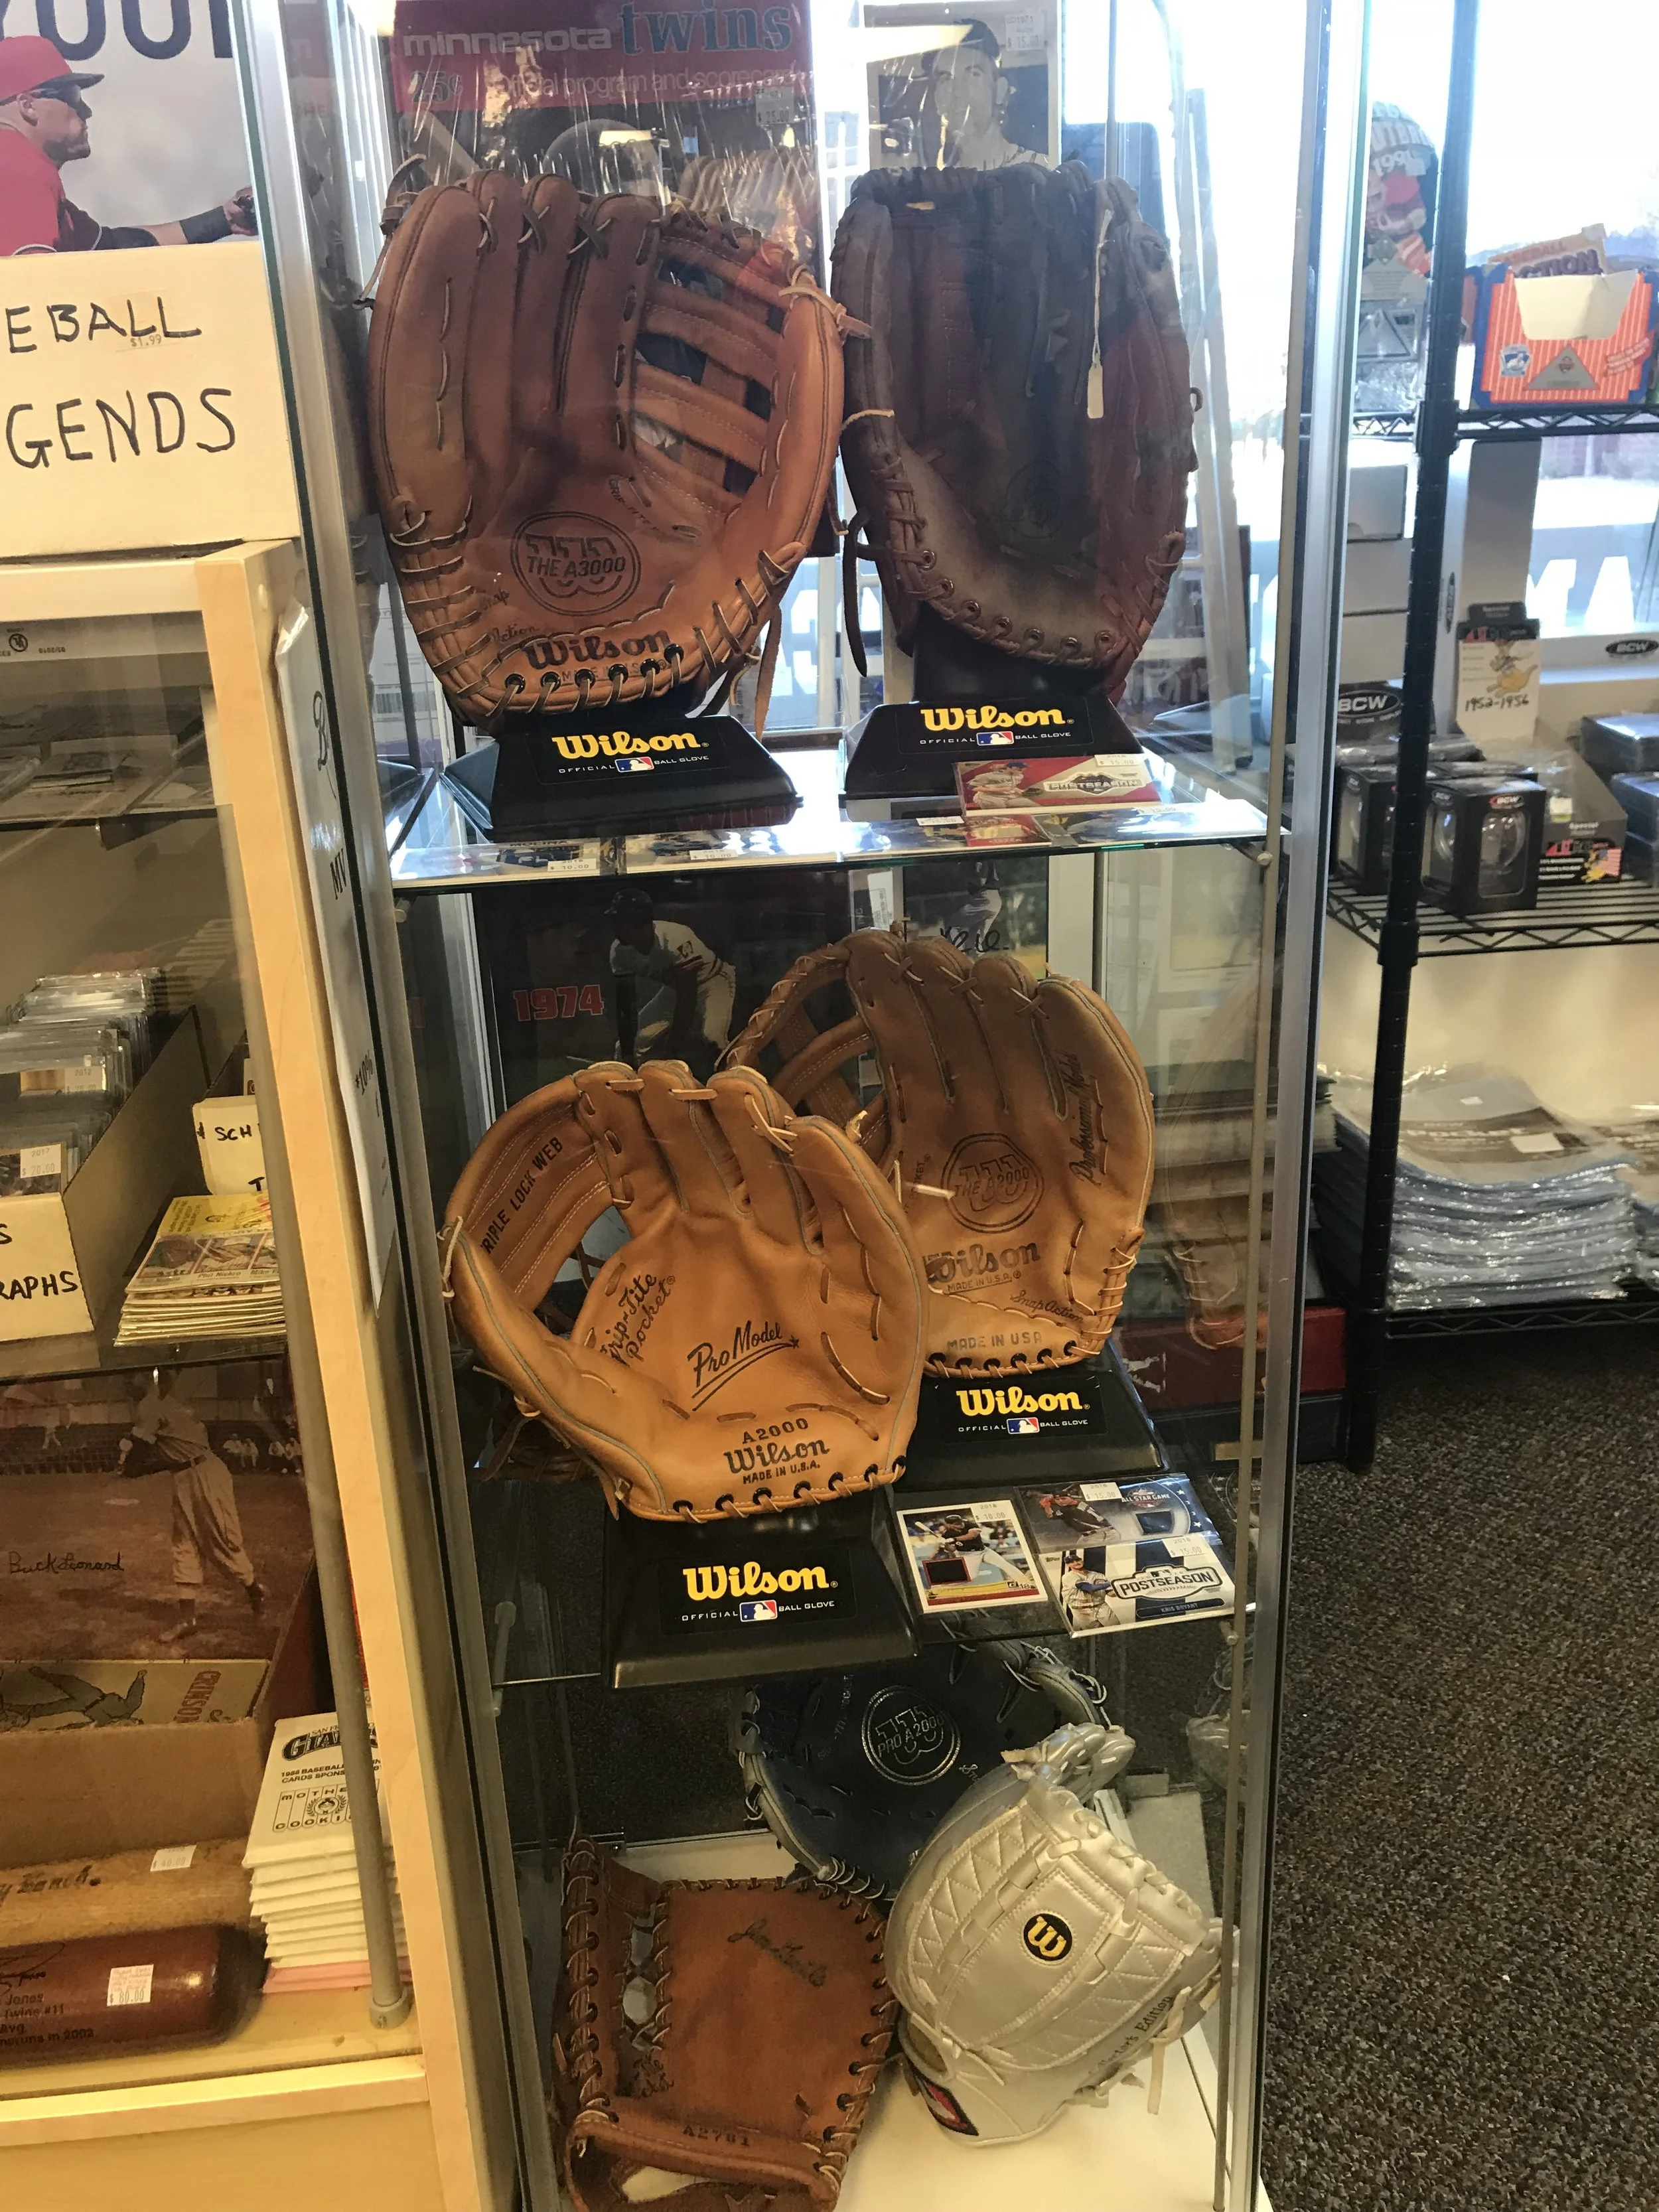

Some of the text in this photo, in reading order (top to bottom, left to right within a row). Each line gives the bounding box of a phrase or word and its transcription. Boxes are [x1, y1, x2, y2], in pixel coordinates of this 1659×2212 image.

[403, 0, 792, 56] minnesota twins
[6, 297, 202, 353] EBALL
[130, 334, 161, 347] $1.99
[6, 388, 235, 469] GENDS
[527, 556, 626, 577] THE A3000
[522, 630, 671, 670] Wilson
[1338, 695, 1388, 712] BCW
[559, 765, 615, 773] OFFICIAL
[512, 984, 605, 1022] 1974
[31, 1147, 50, 1158] 2017
[31, 1163, 56, 1176] 20.00
[511, 1173, 536, 1212] LOCK
[532, 1136, 564, 1173] WEB
[948, 1281, 973, 1291] MADE
[1009, 1290, 1045, 1313] Snap
[947, 1331, 1044, 1350] MADE IN USA
[687, 1320, 783, 1388] Pro Model
[742, 1418, 809, 1445] A2000
[723, 1439, 830, 1474] Wilson
[743, 1459, 820, 1484] MADE IN U.S.A.
[1094, 1491, 1117, 1500] 15.00
[1151, 1492, 1171, 1501] GAME
[1180, 1546, 1203, 1556] 15.00
[8, 1551, 58, 1575] Buck
[1121, 1570, 1214, 1594] POSTSEASON
[682, 1600, 835, 1621] OFFICIAL BALL GLOVE
[281, 1774, 313, 1784] CARDS
[1135, 1994, 1174, 2033] Edition
